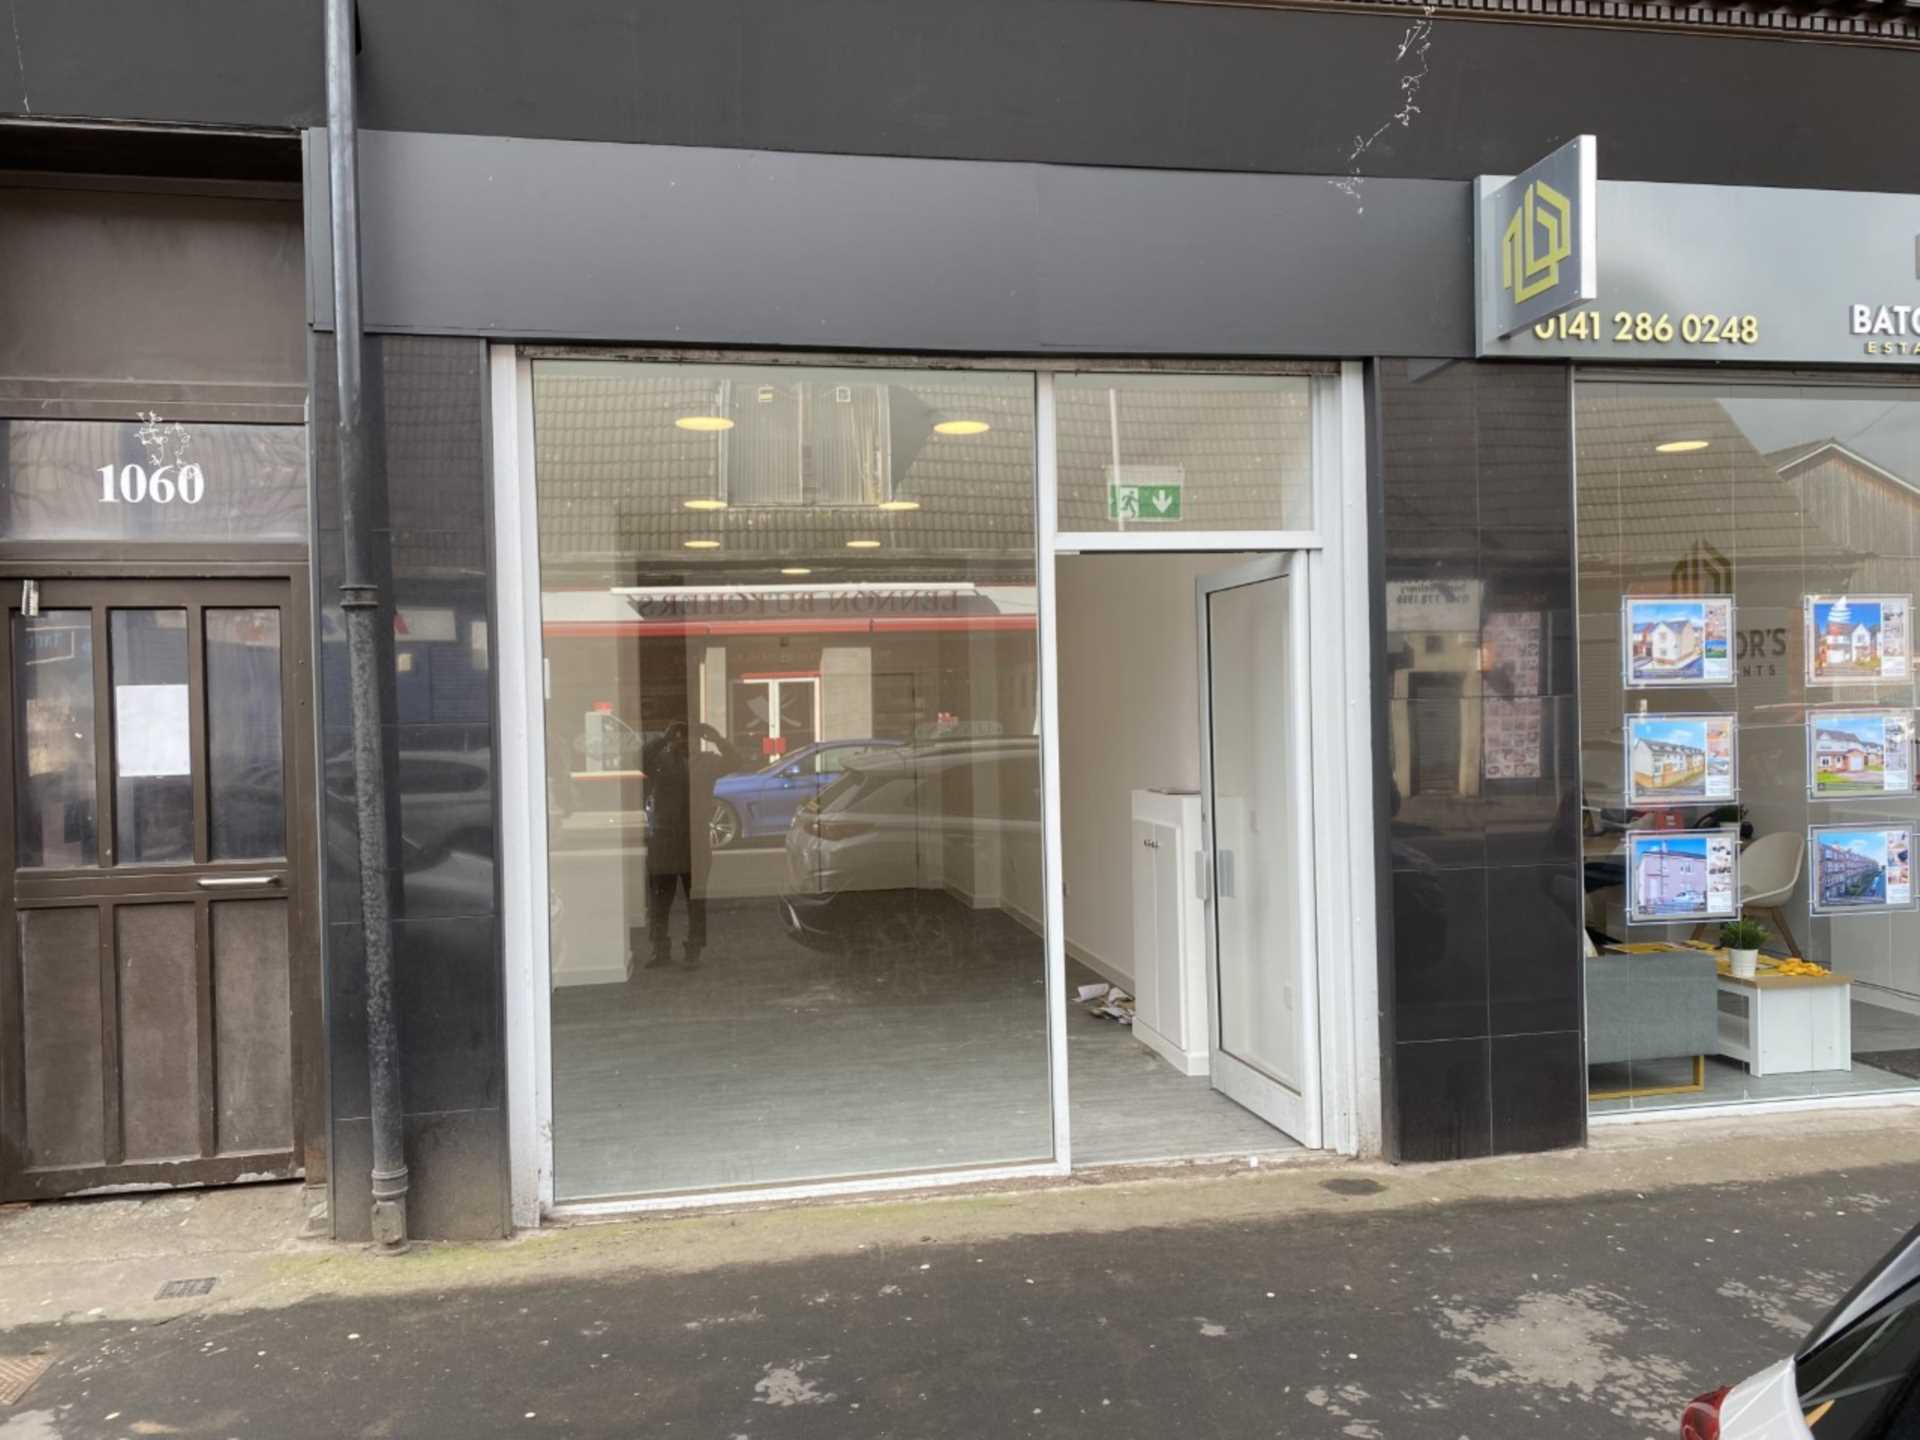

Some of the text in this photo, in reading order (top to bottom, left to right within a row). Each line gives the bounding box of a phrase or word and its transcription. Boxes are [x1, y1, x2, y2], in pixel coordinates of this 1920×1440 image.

[1535, 311, 1759, 344] 0141 286 0248
[96, 463, 204, 504] 1060
